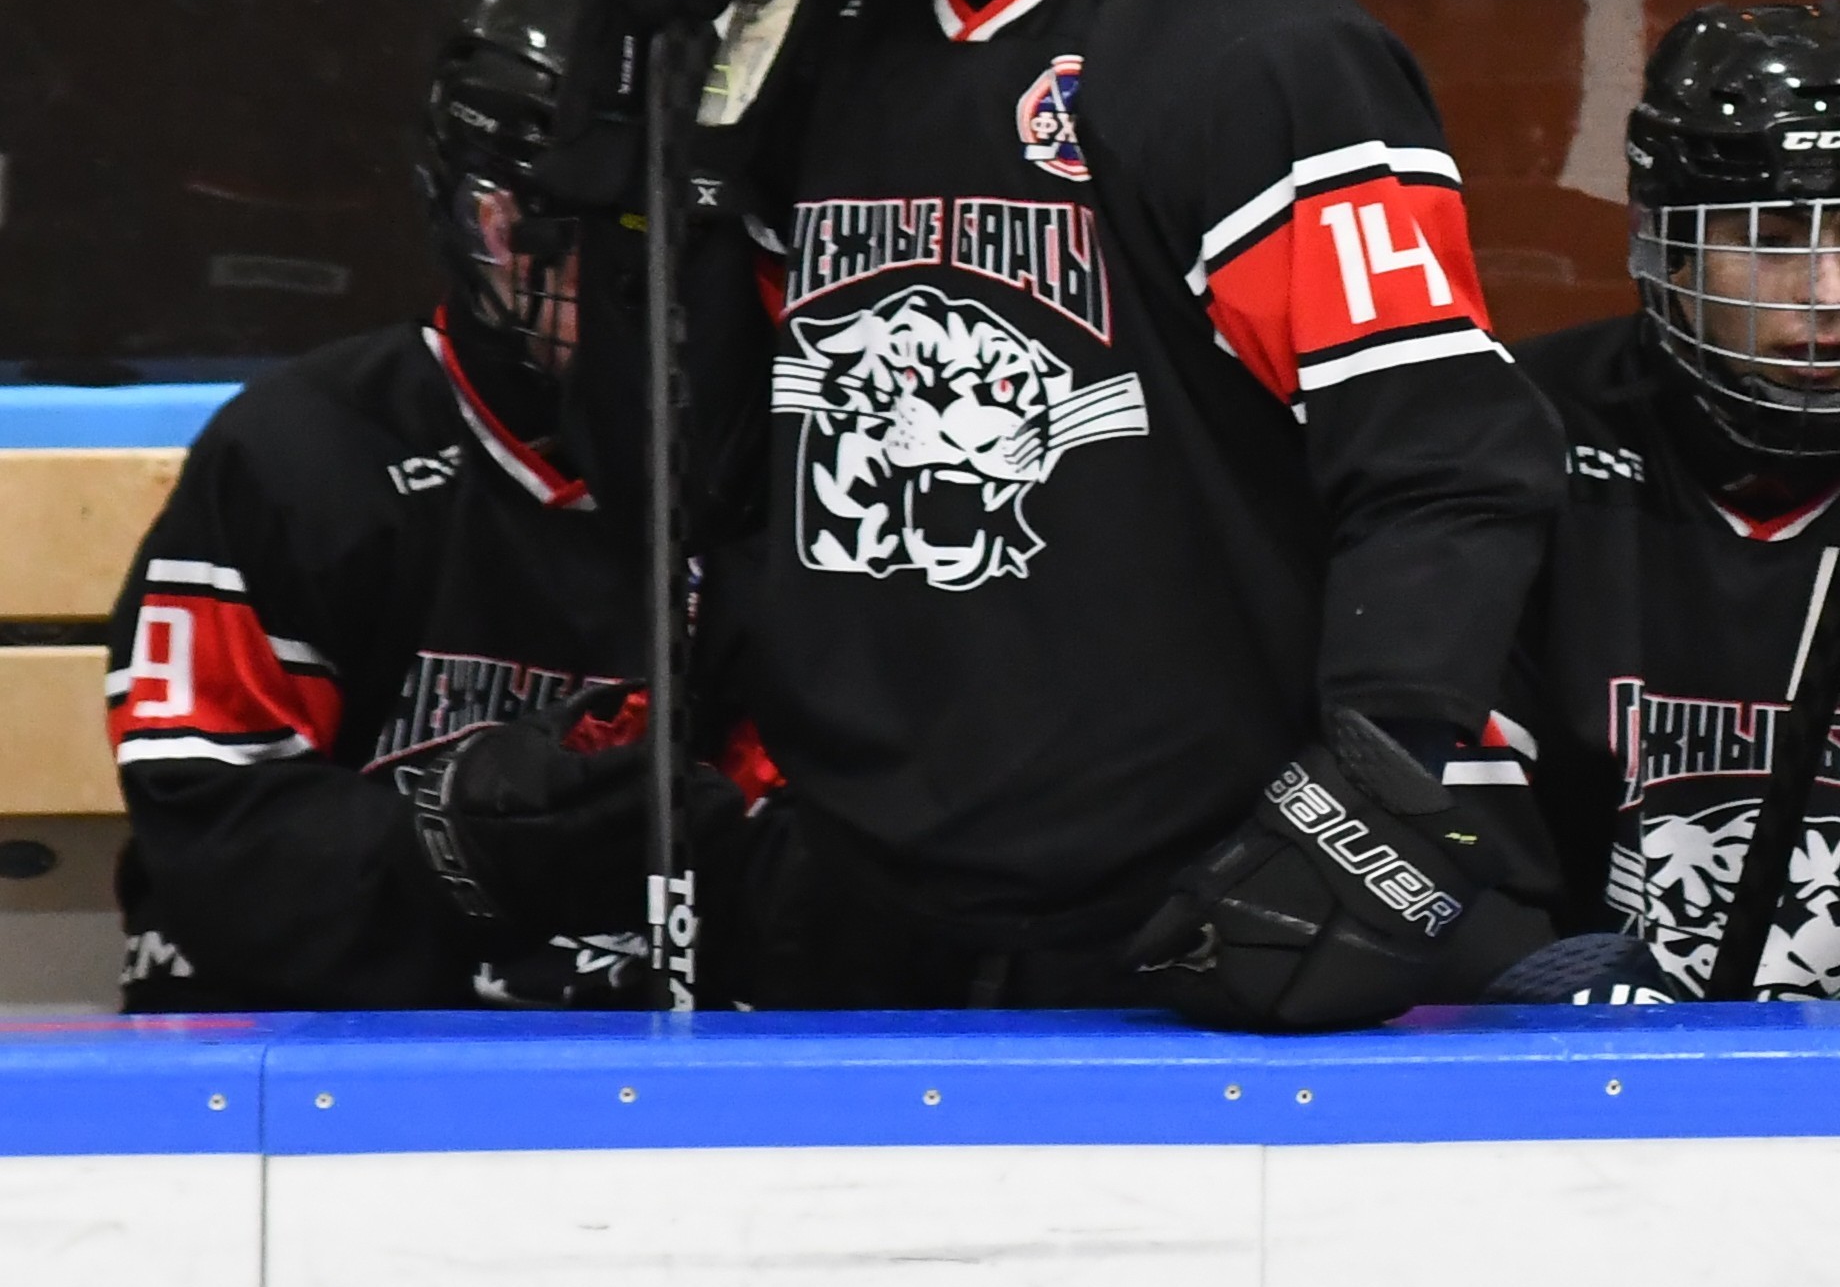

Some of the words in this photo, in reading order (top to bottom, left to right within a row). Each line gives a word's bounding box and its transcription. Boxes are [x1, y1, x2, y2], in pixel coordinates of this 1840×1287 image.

[951, 196, 1113, 348] БАРСЫ
[1320, 201, 1452, 324] 14
[133, 605, 193, 718] 9
[1263, 761, 1463, 938] BAUER
